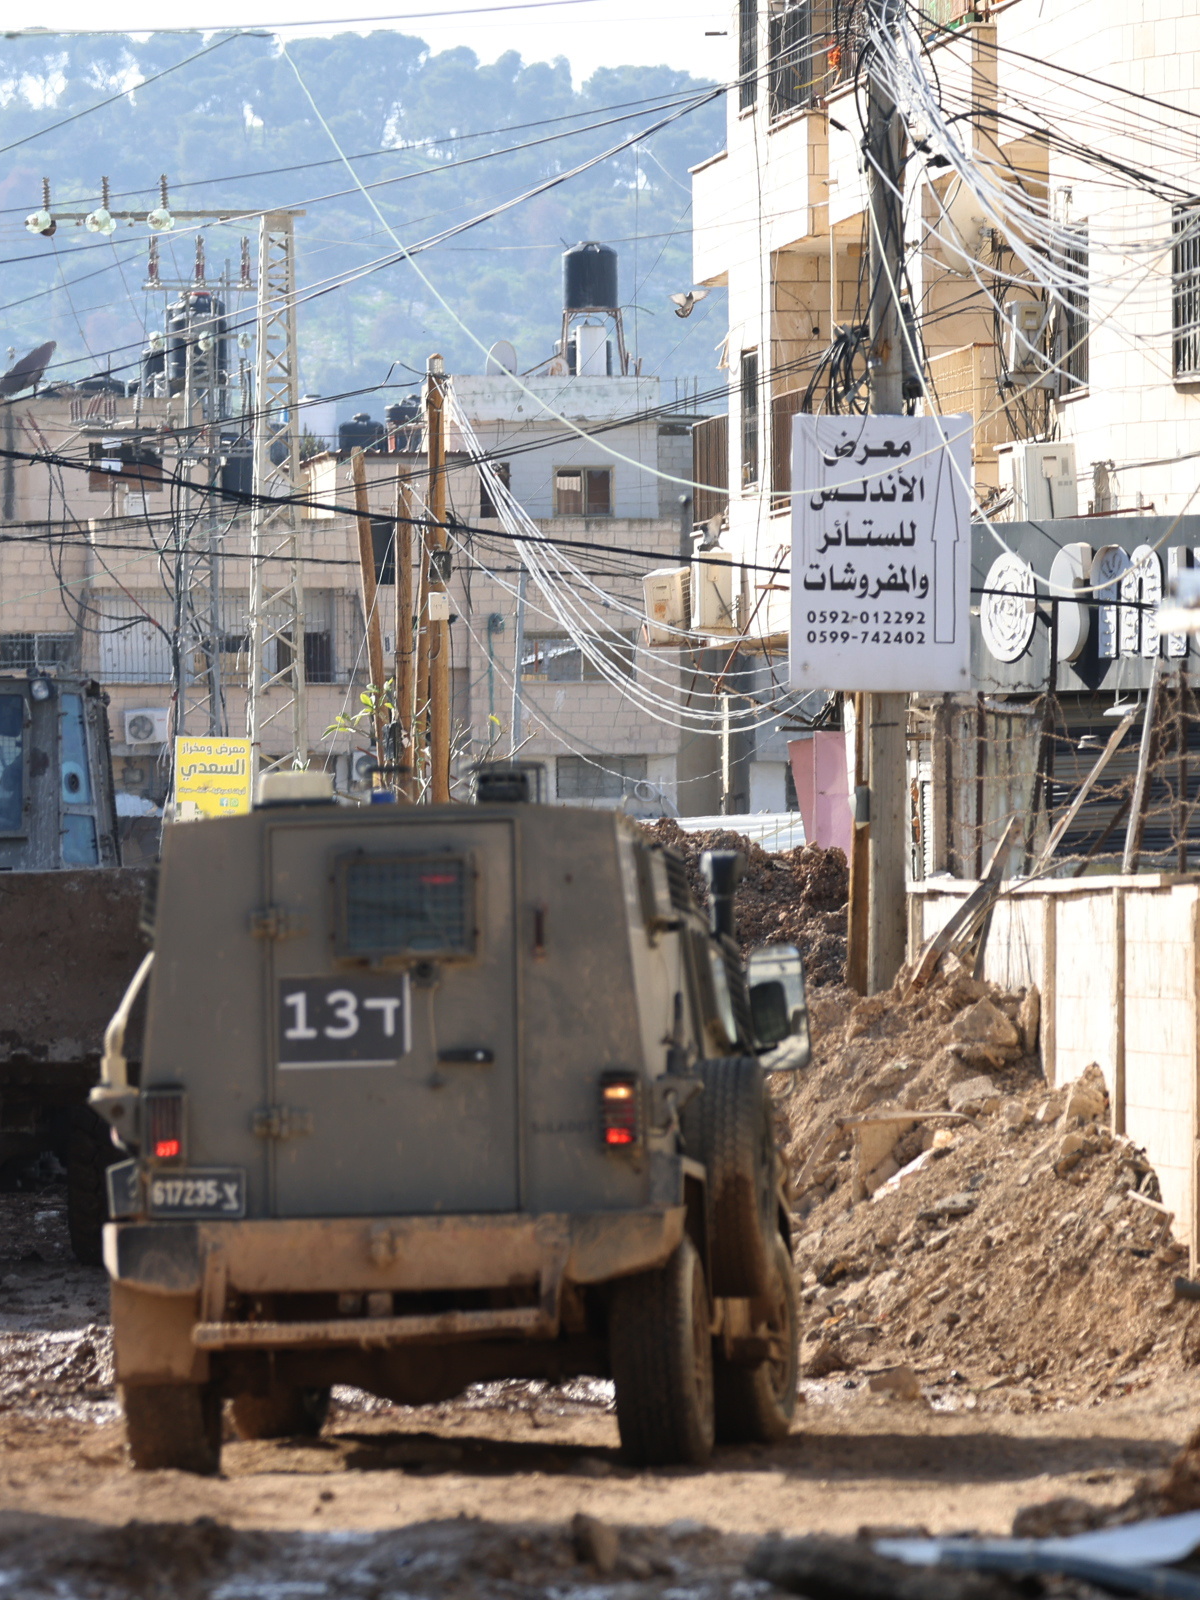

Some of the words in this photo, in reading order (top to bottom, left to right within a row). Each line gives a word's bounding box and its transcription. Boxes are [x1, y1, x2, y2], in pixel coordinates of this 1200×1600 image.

[822, 430, 912, 466] معرض
[810, 466, 925, 511] الأندلس
[815, 519, 917, 554] للستائر
[803, 561, 930, 599] والمفروشات
[806, 610, 926, 625] 0592-012292
[806, 630, 926, 644] 0599-742402
[215, 743, 246, 756] معرض
[181, 758, 245, 780] السعدي
